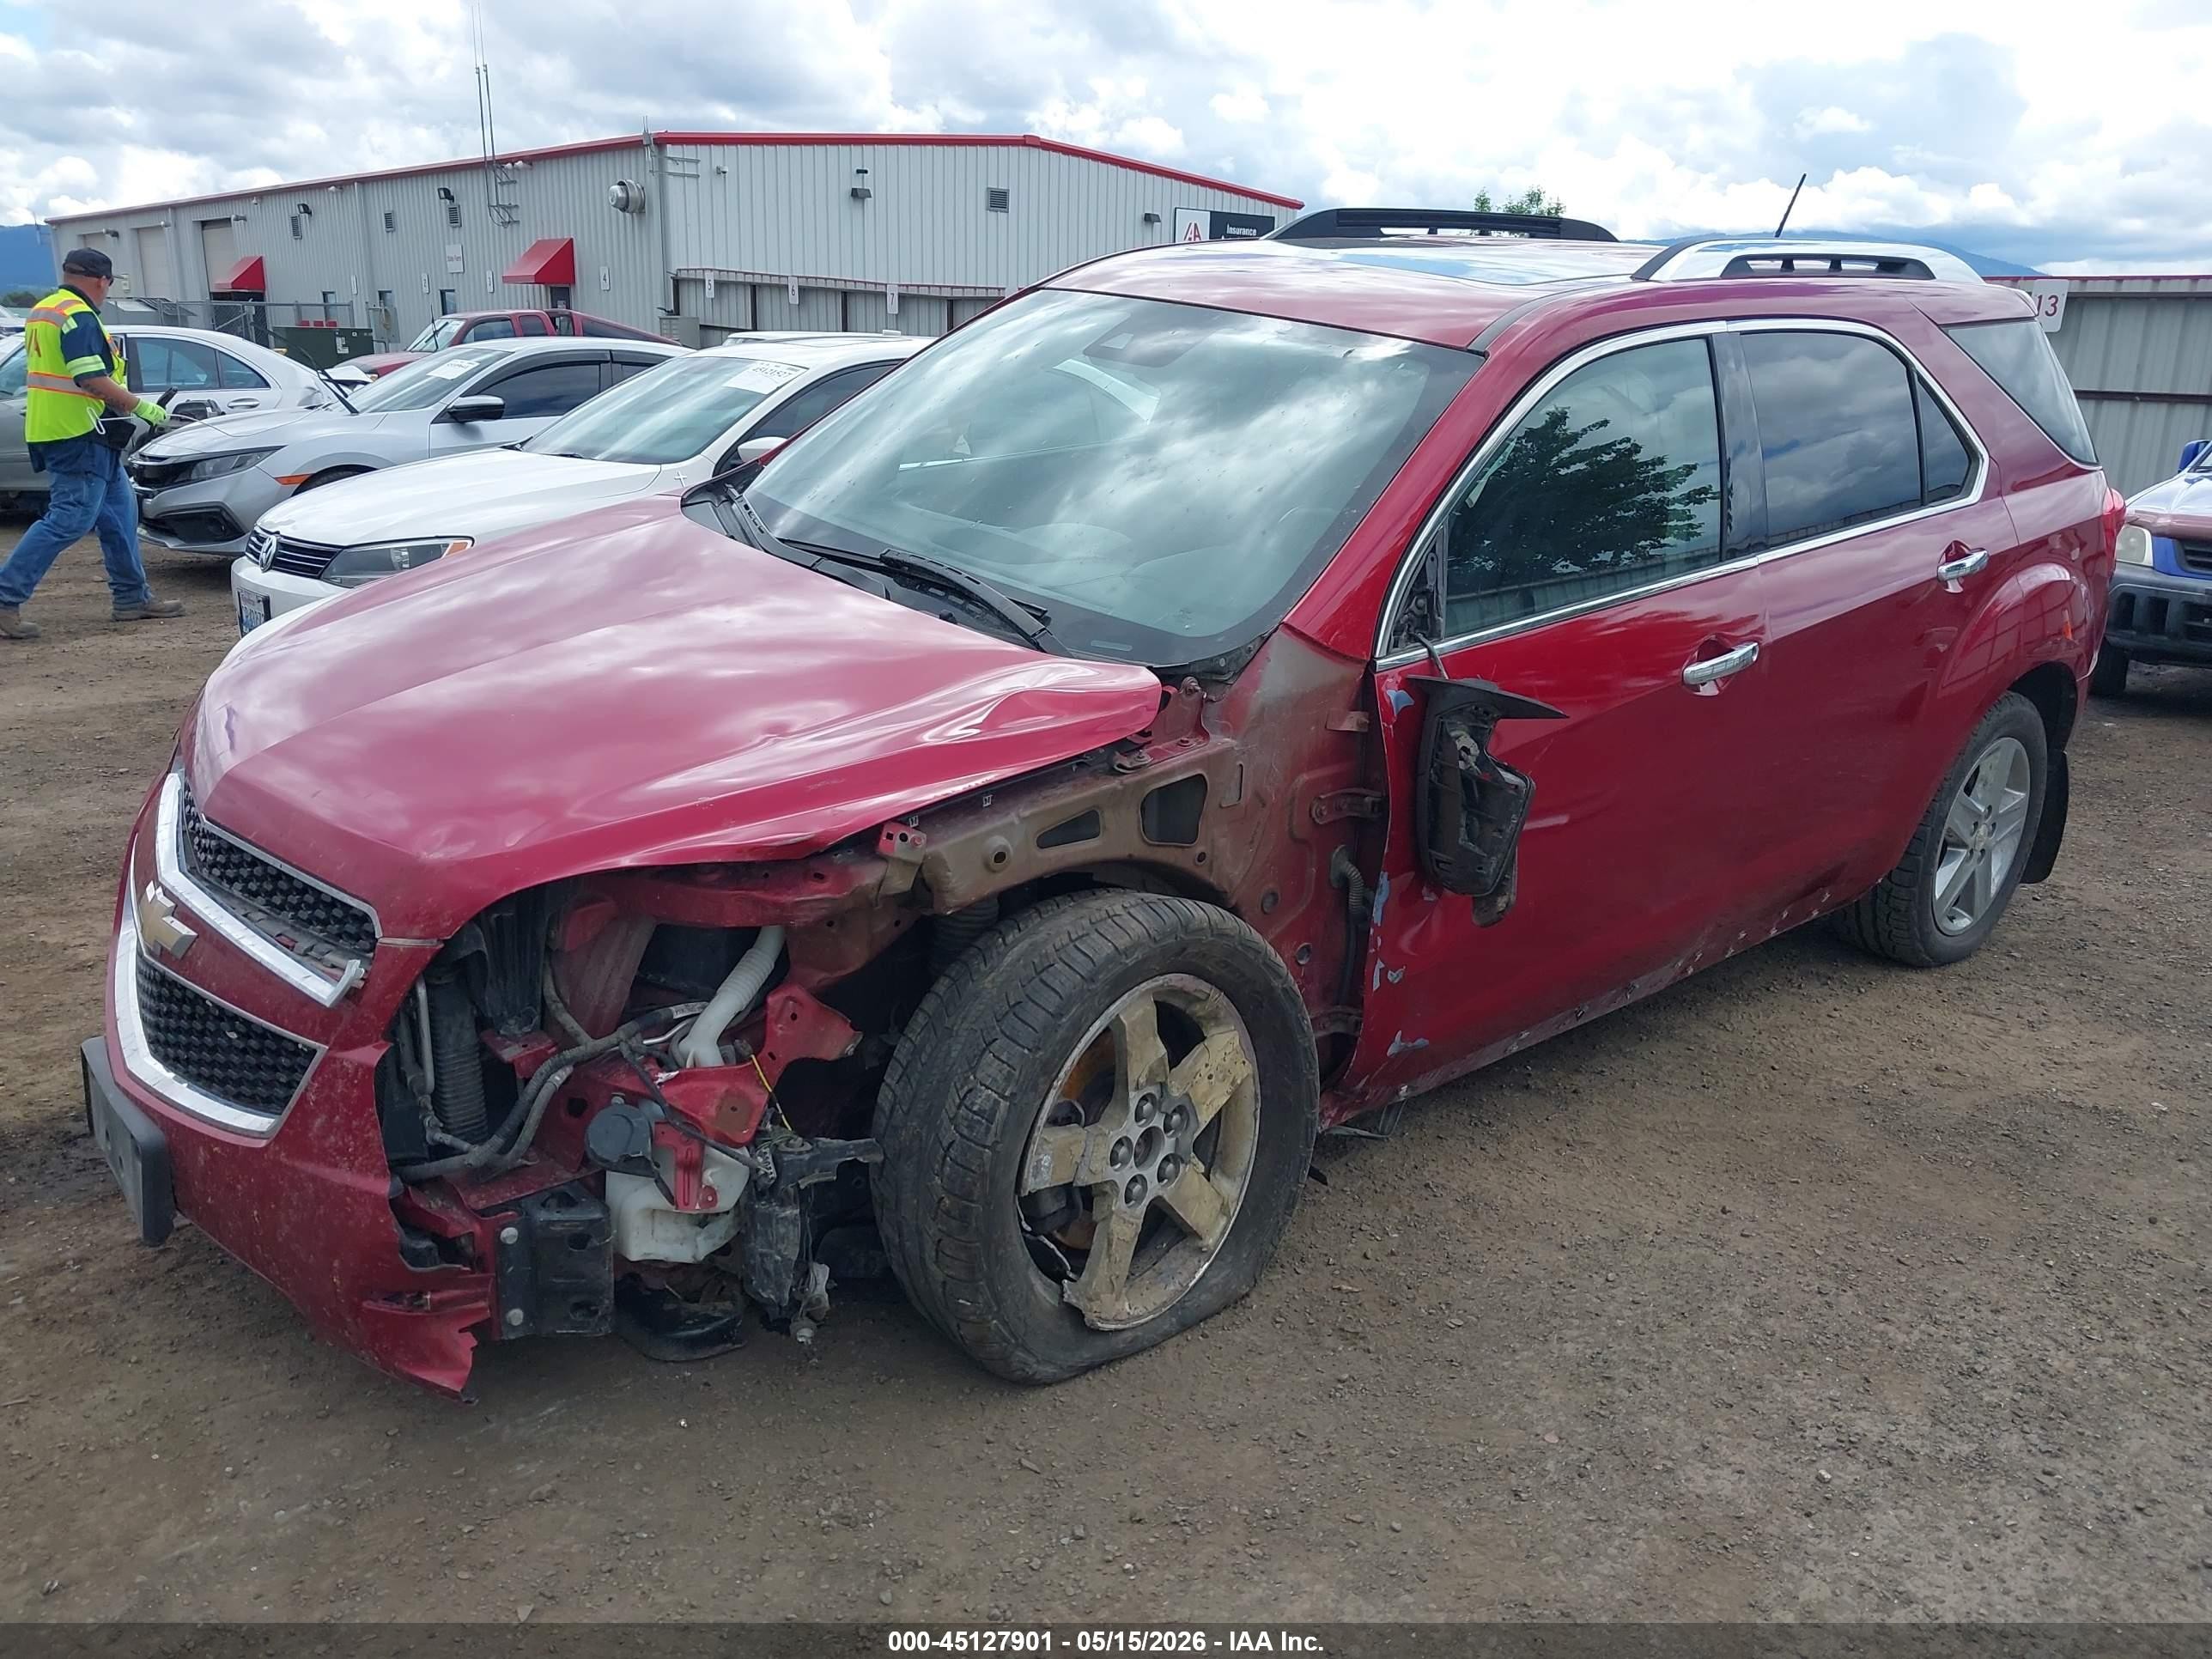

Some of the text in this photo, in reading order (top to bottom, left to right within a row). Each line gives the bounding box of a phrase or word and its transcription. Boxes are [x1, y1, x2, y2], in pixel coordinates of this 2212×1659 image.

[1226, 222, 1257, 236] Insurance
[603, 272, 607, 284] 4
[708, 279, 712, 290] 5
[791, 285, 796, 295] 6
[890, 293, 895, 307] 7
[2037, 295, 2059, 317] 13
